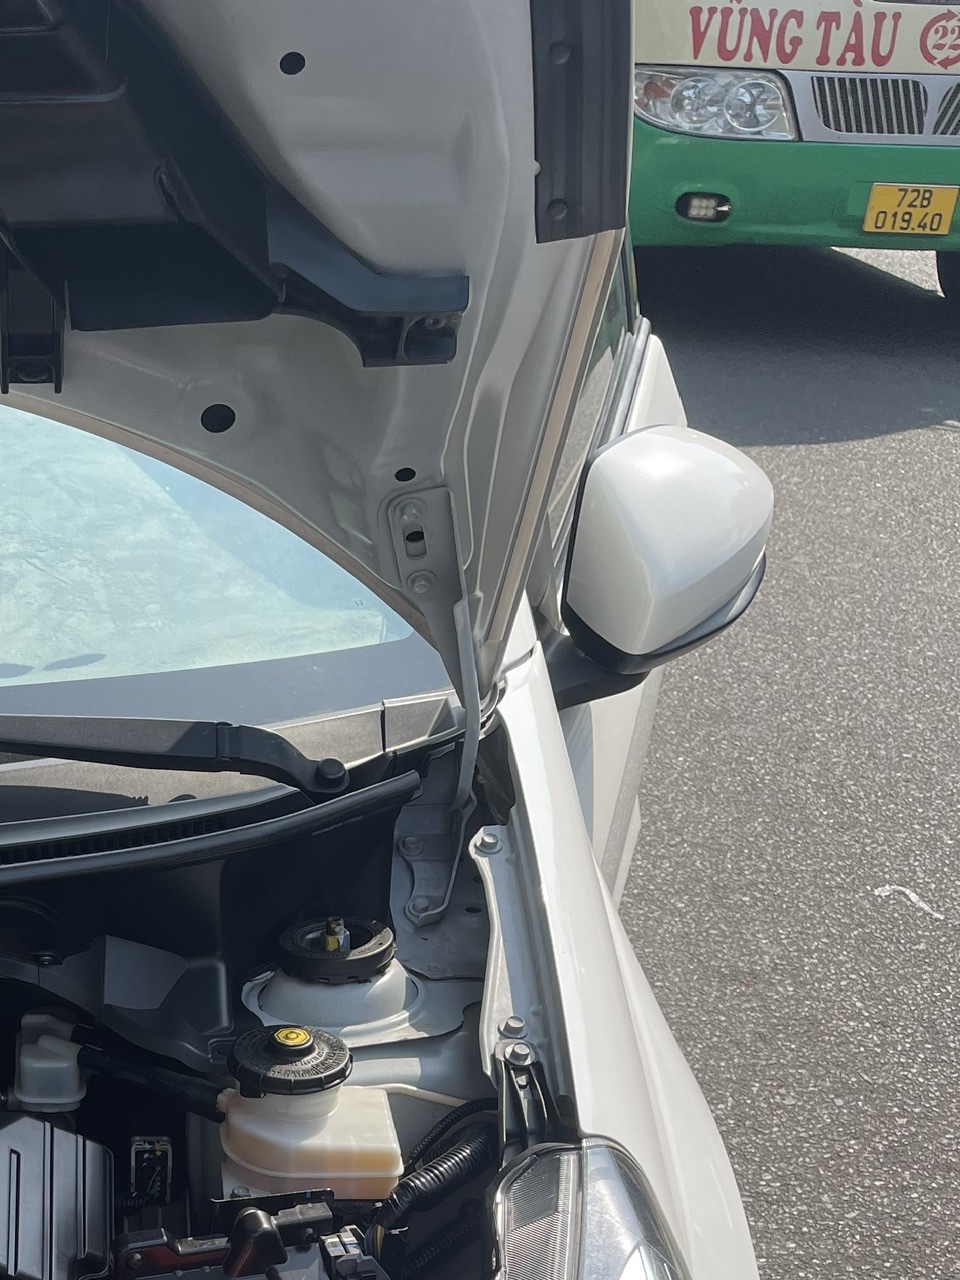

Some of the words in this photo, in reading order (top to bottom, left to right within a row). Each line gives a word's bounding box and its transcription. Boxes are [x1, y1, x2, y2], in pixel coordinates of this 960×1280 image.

[815, 0, 902, 67] TÀU
[896, 188, 933, 208] 72B
[874, 210, 943, 232] 019.40
